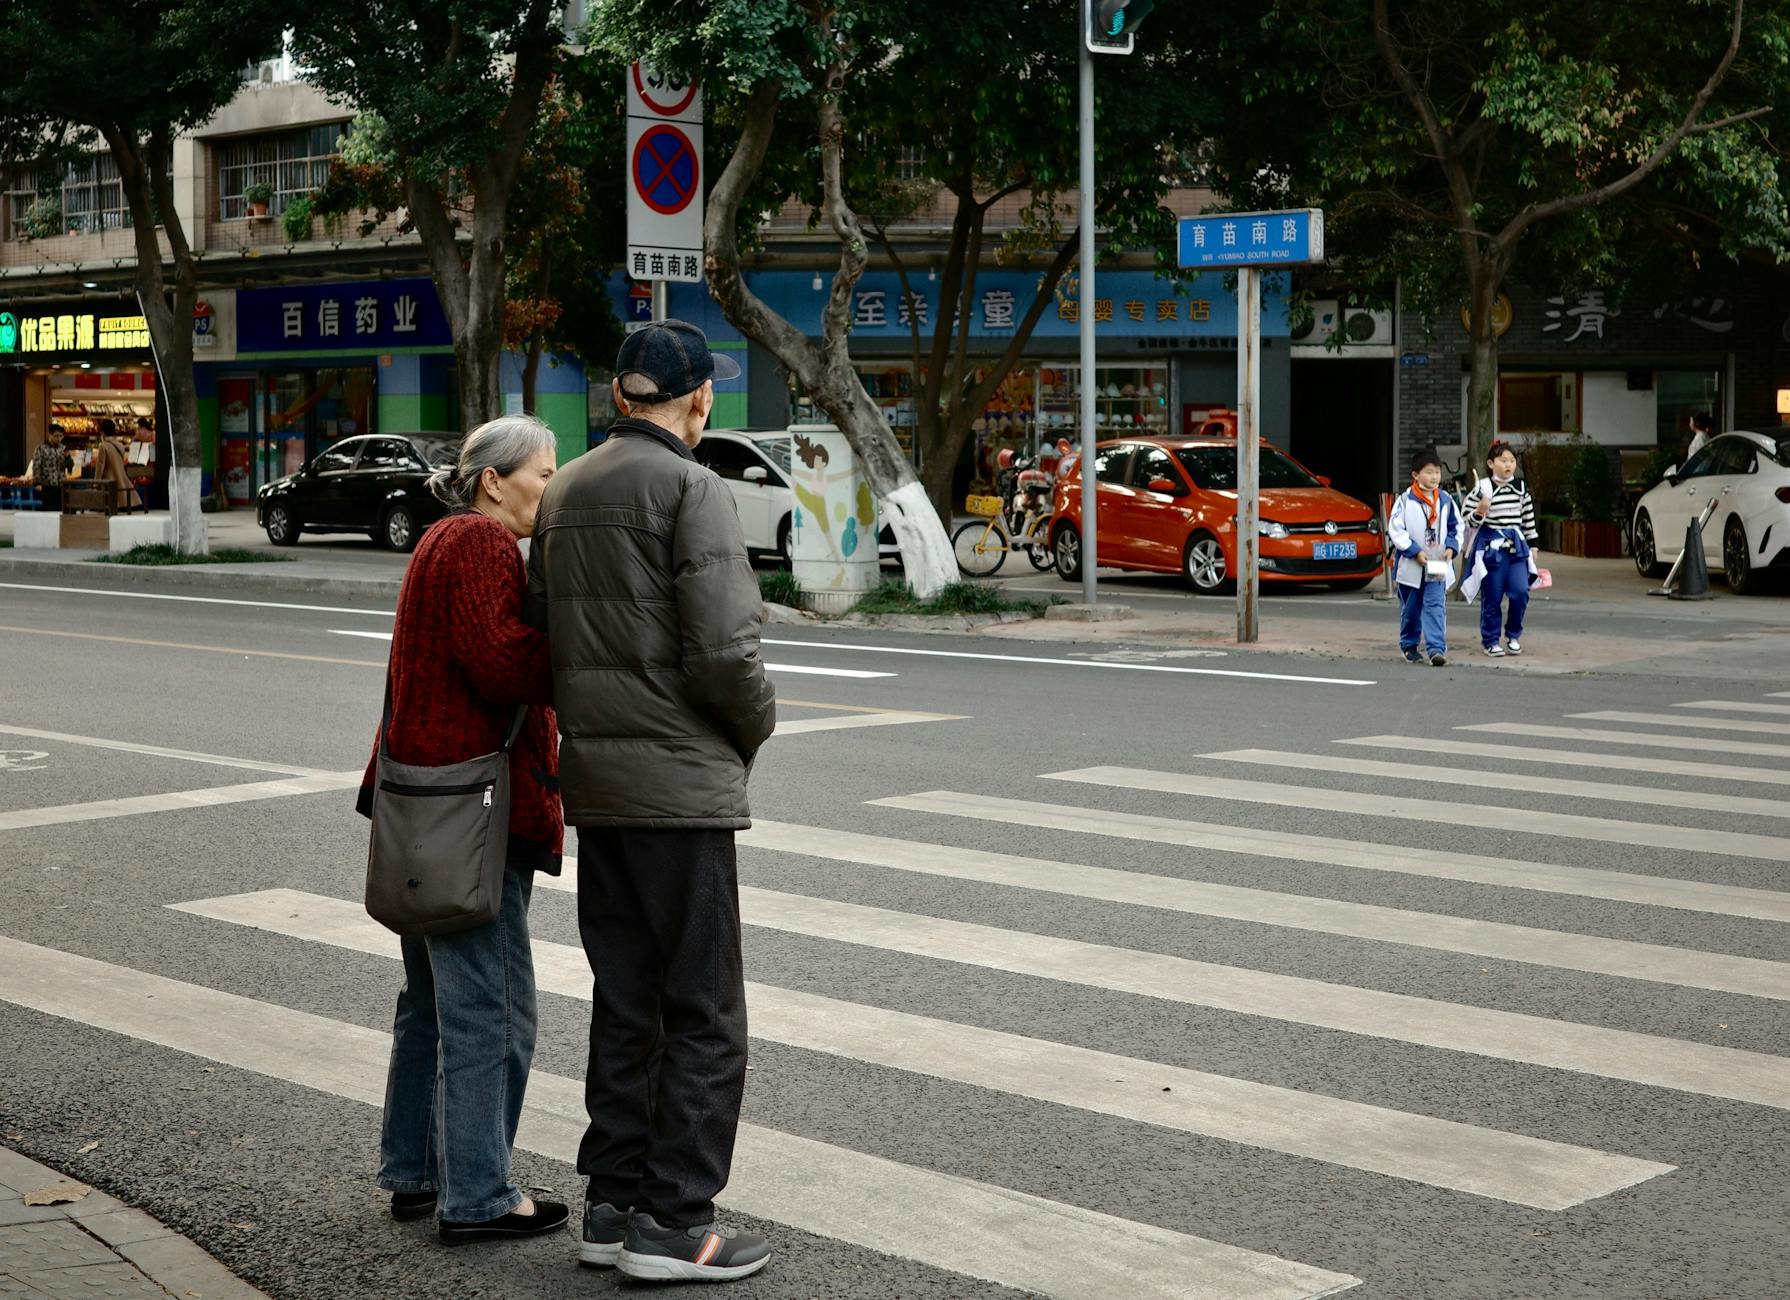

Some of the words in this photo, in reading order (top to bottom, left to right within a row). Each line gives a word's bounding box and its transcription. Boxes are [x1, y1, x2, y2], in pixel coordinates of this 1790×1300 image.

[1192, 218, 1297, 248] 育苗南路
[632, 251, 698, 277] 育苗南路
[1247, 251, 1269, 259] SOUTH
[1272, 250, 1289, 258] ROAD
[282, 295, 416, 338] 百信药业
[854, 291, 1015, 328] 至亲童
[1057, 299, 1211, 322] 母婴专卖店
[20, 315, 94, 352] 优品果源
